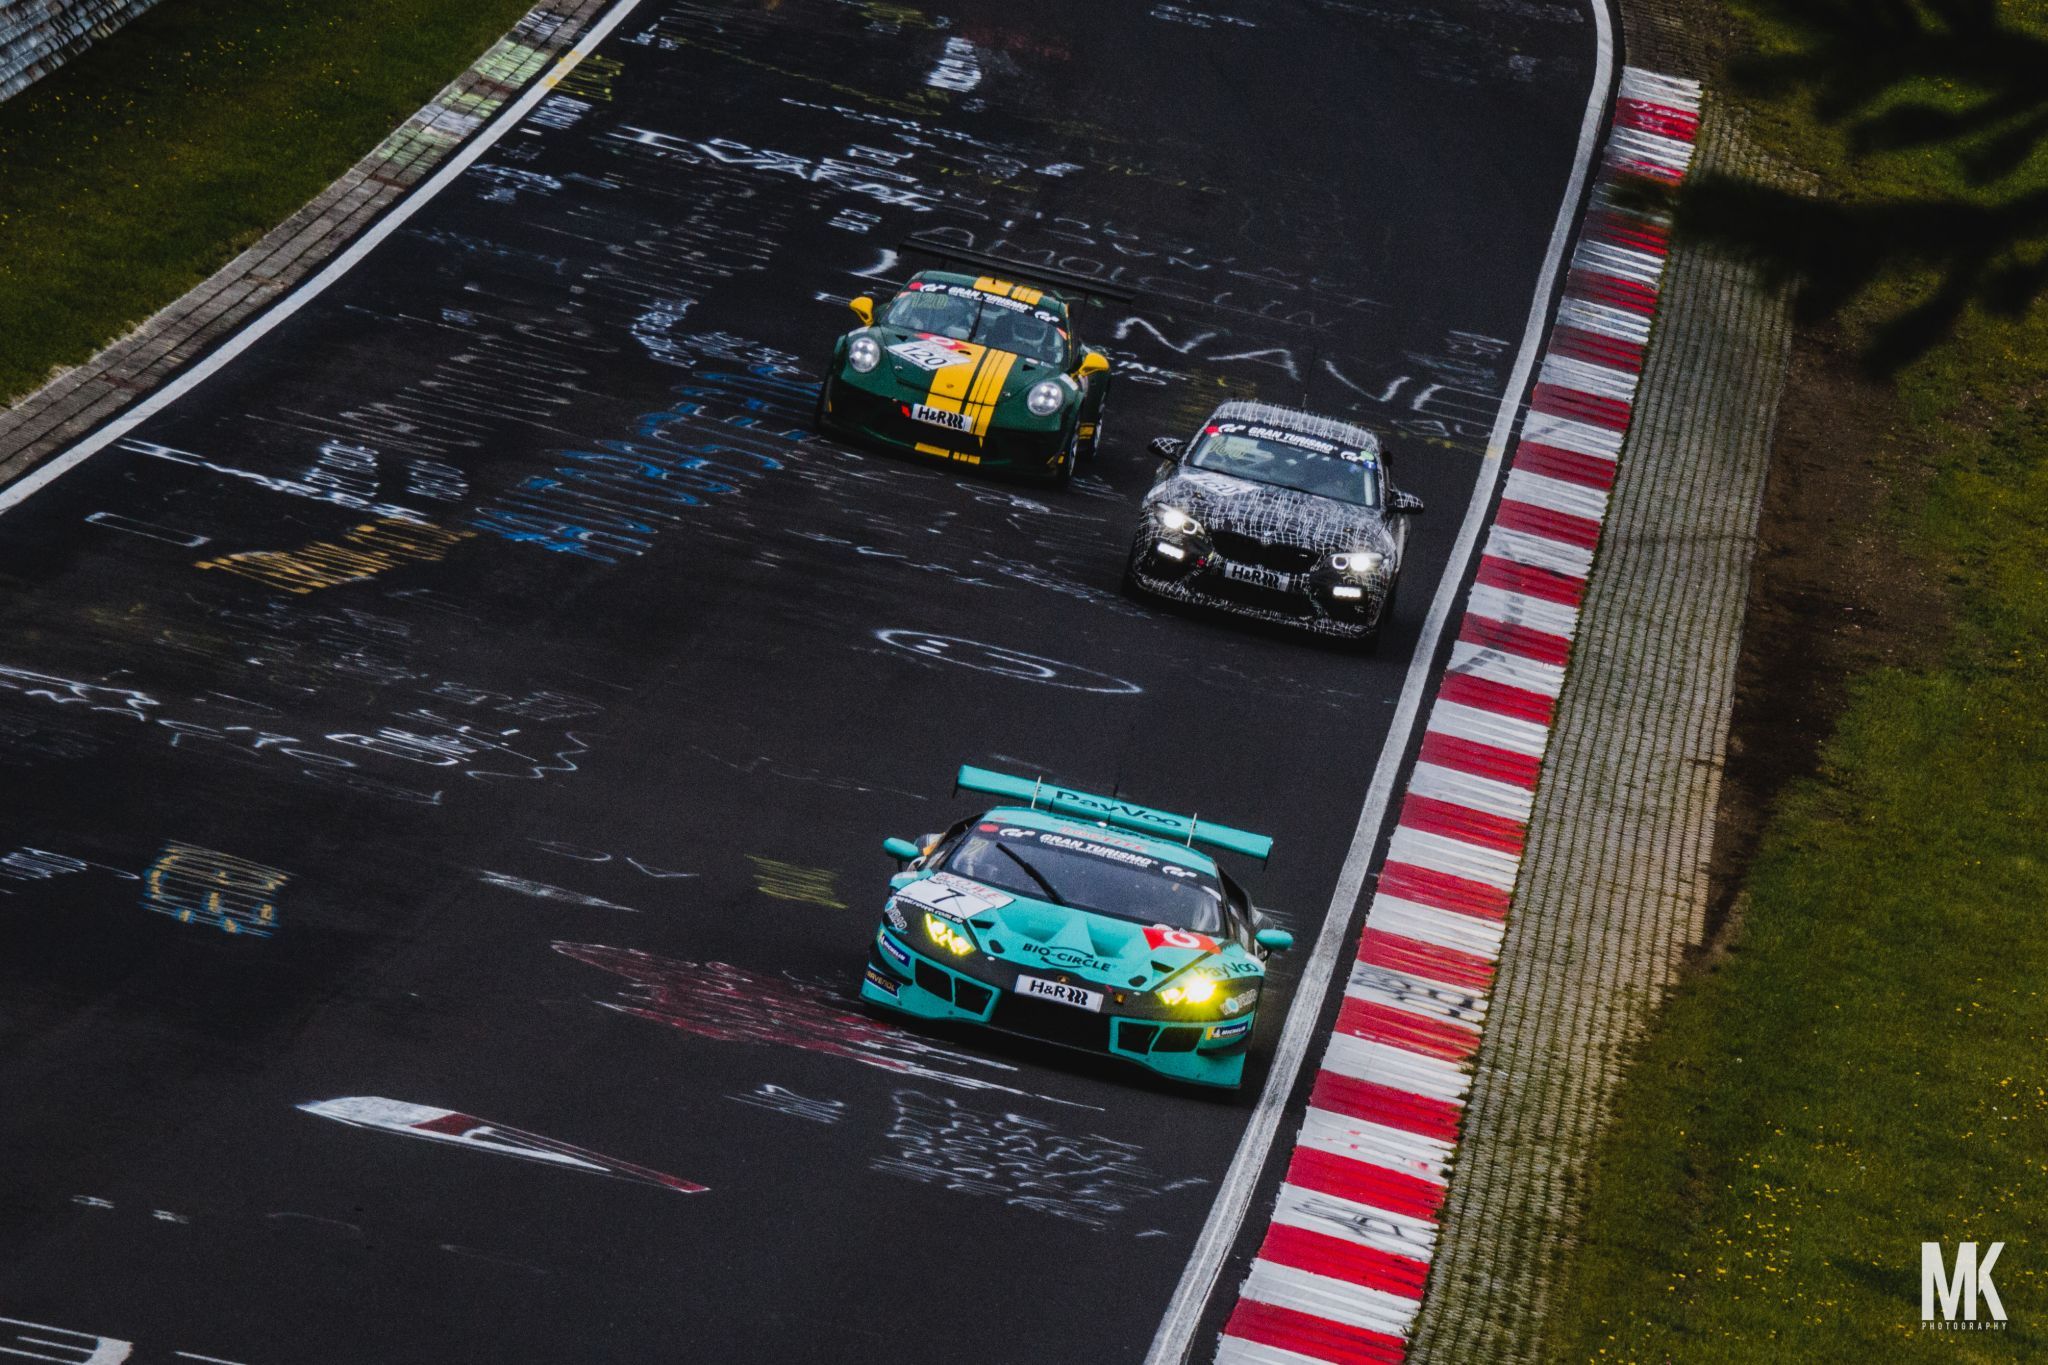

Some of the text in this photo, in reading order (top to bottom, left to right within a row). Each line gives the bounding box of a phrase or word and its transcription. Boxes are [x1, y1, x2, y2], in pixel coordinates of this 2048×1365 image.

[903, 346, 947, 365] 120
[1249, 426, 1282, 439] GRAN
[1283, 431, 1333, 451] TURISMO
[1040, 834, 1083, 848] GRAN
[1086, 842, 1151, 866] TURISMO
[931, 888, 966, 904] 7
[1022, 943, 1111, 972] BIO-CIRCLE
